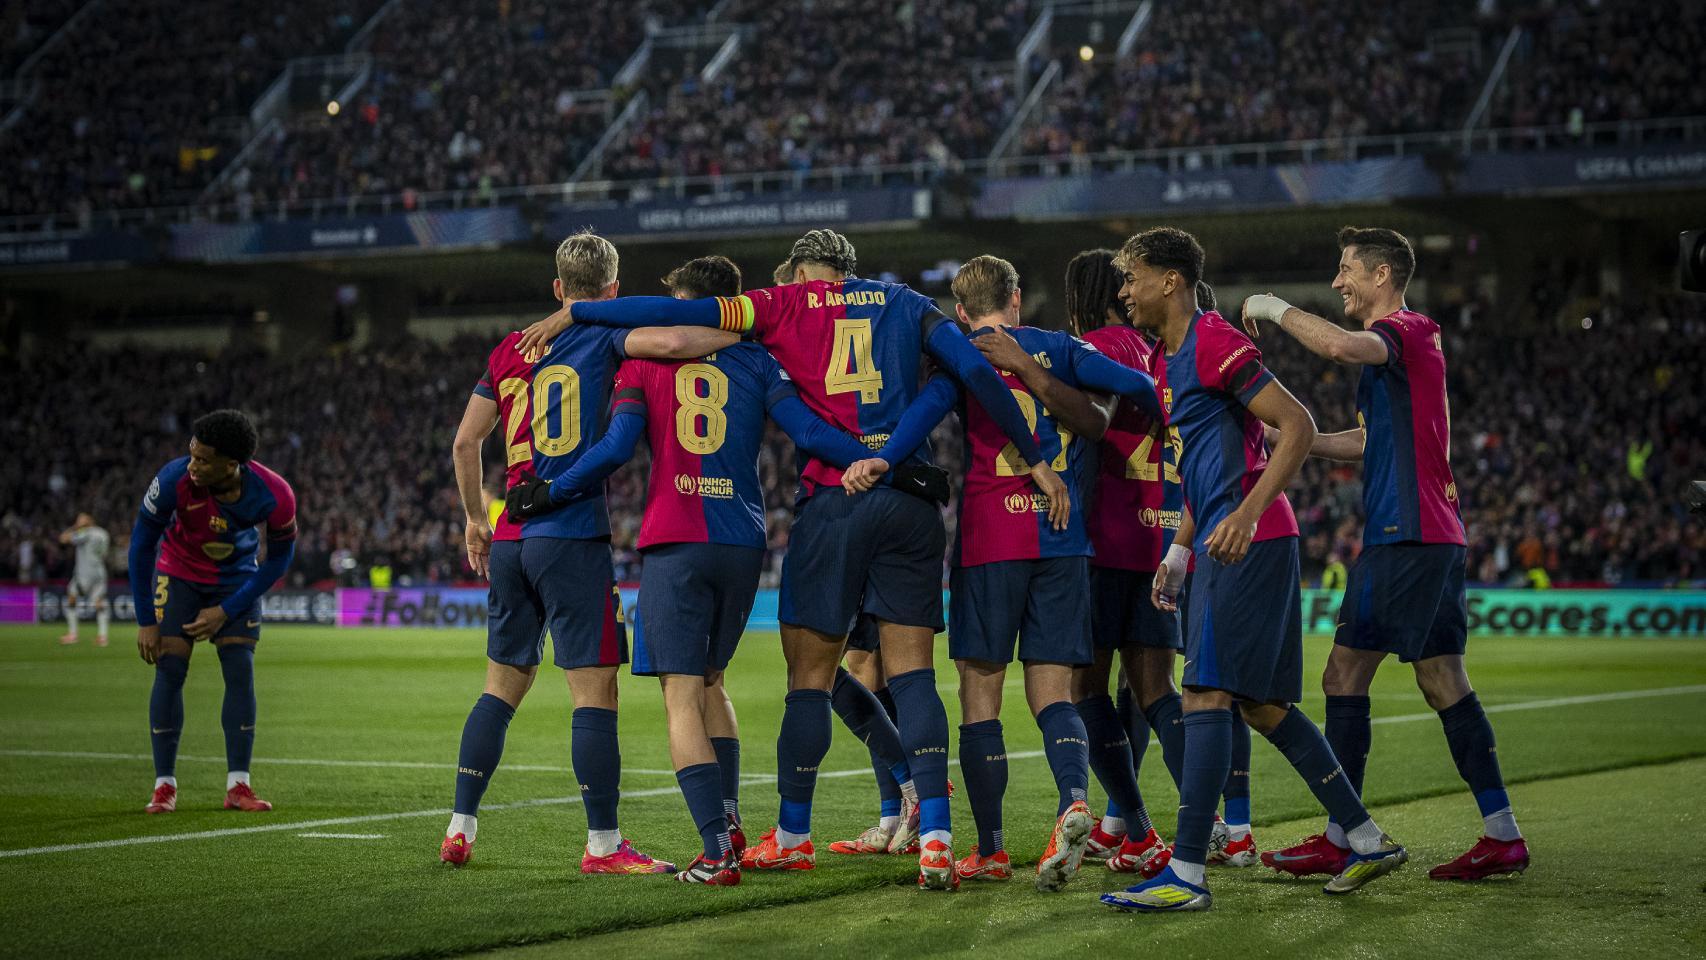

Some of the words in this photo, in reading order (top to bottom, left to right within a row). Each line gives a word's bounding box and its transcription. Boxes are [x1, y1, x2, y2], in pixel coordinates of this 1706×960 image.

[808, 292, 822, 309] R.
[825, 318, 883, 405] 4
[1218, 345, 1248, 374] AMBILIGHT
[498, 364, 582, 468] 20
[675, 363, 729, 455] 8
[860, 433, 890, 444] UNHC
[697, 476, 733, 487] UNHCR
[697, 485, 733, 496] ACNUR
